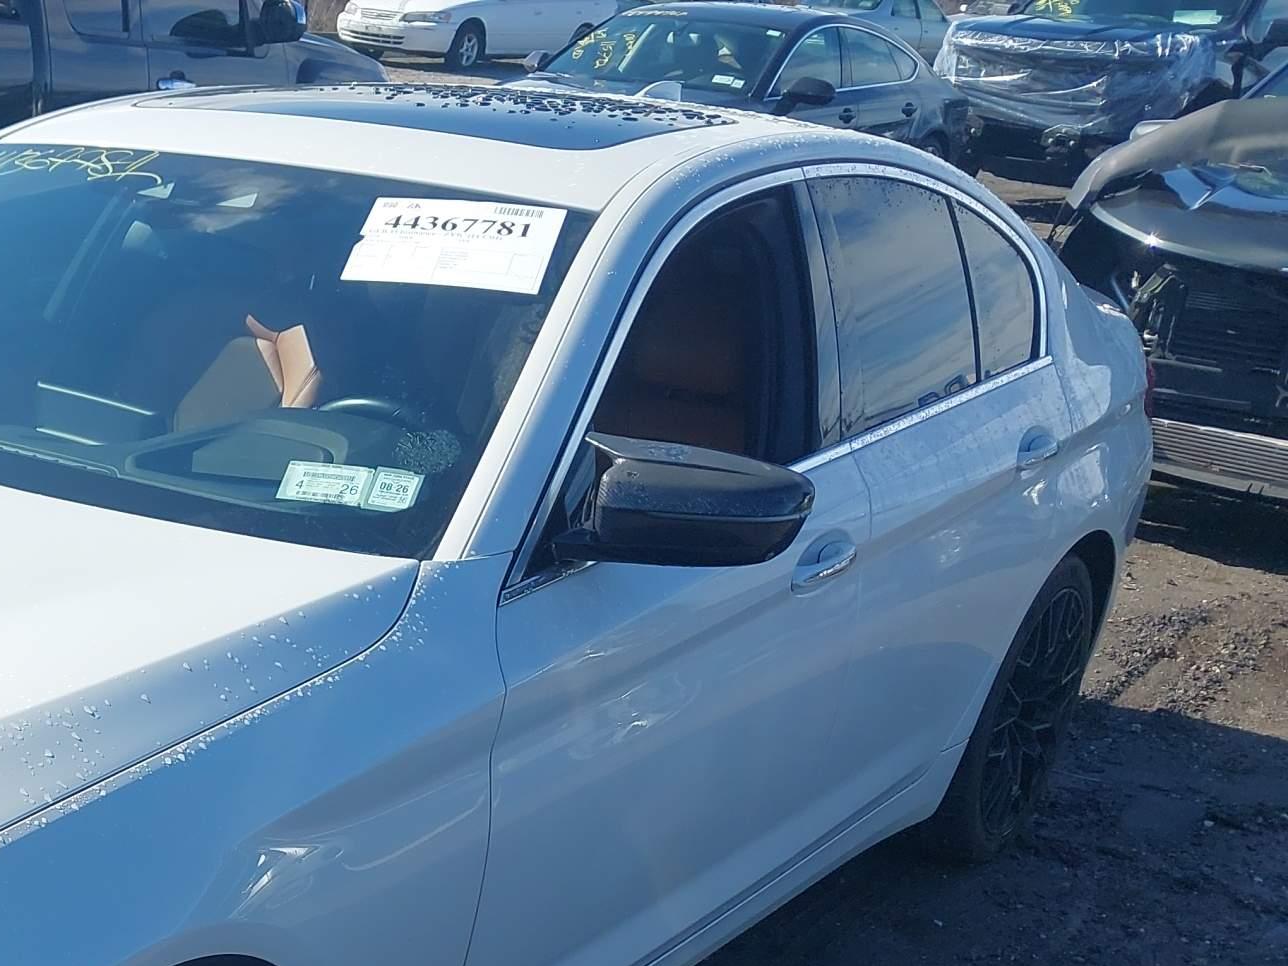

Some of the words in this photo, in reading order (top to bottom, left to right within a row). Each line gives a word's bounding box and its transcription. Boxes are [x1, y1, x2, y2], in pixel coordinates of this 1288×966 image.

[384, 214, 532, 238] 44367781
[295, 480, 304, 490] 4
[339, 483, 359, 496] 26
